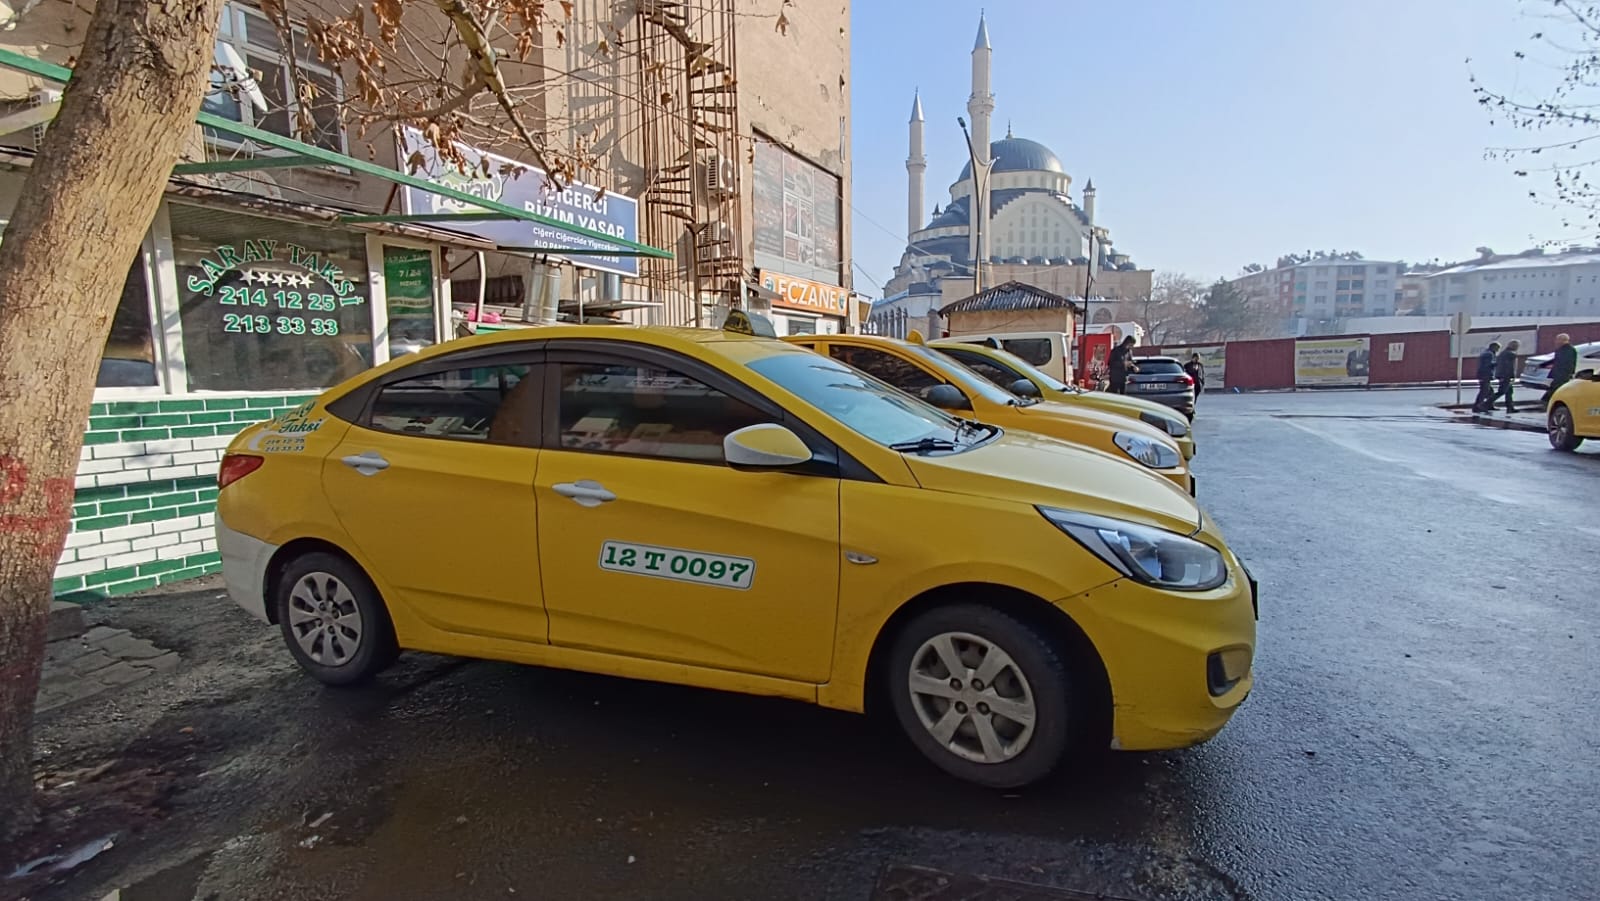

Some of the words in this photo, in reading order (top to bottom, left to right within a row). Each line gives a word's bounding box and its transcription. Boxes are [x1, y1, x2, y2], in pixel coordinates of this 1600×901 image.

[533, 227, 555, 239] Ciğeri
[534, 240, 548, 249] ALO
[187, 239, 278, 297] SARAY
[219, 286, 267, 306] 214
[274, 291, 303, 310] 12
[308, 293, 336, 312] 25
[778, 278, 837, 310] ECZANE
[224, 314, 271, 333] 213
[277, 316, 306, 335] 33
[311, 318, 338, 336] 33
[278, 418, 323, 433] Taksi
[604, 546, 637, 567] 12
[644, 551, 666, 570] T
[670, 555, 749, 582] 0097
